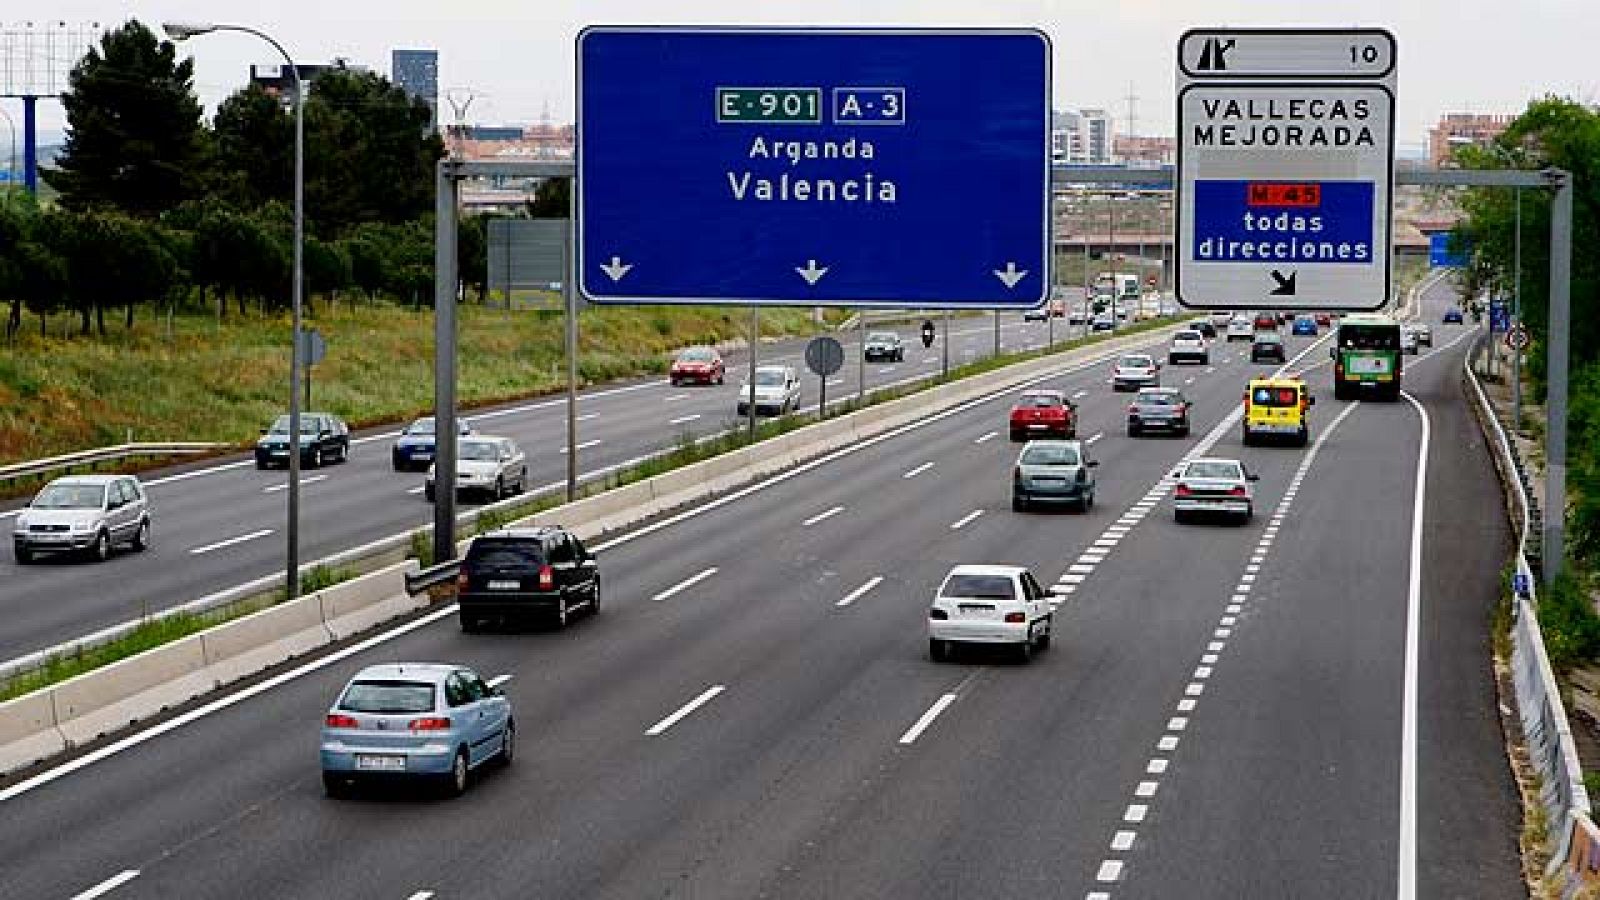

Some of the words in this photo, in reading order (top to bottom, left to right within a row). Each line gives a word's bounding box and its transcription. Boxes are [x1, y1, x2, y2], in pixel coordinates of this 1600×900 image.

[1349, 44, 1379, 64] 10
[721, 94, 817, 116] E-901
[841, 94, 899, 116] A-3
[1202, 99, 1371, 120] VALLECAS
[1194, 125, 1376, 147] MEJORADA
[749, 137, 875, 165] Arganda
[727, 172, 897, 202] Valencia
[1244, 212, 1323, 231] todas
[1199, 237, 1369, 259] direcciones
